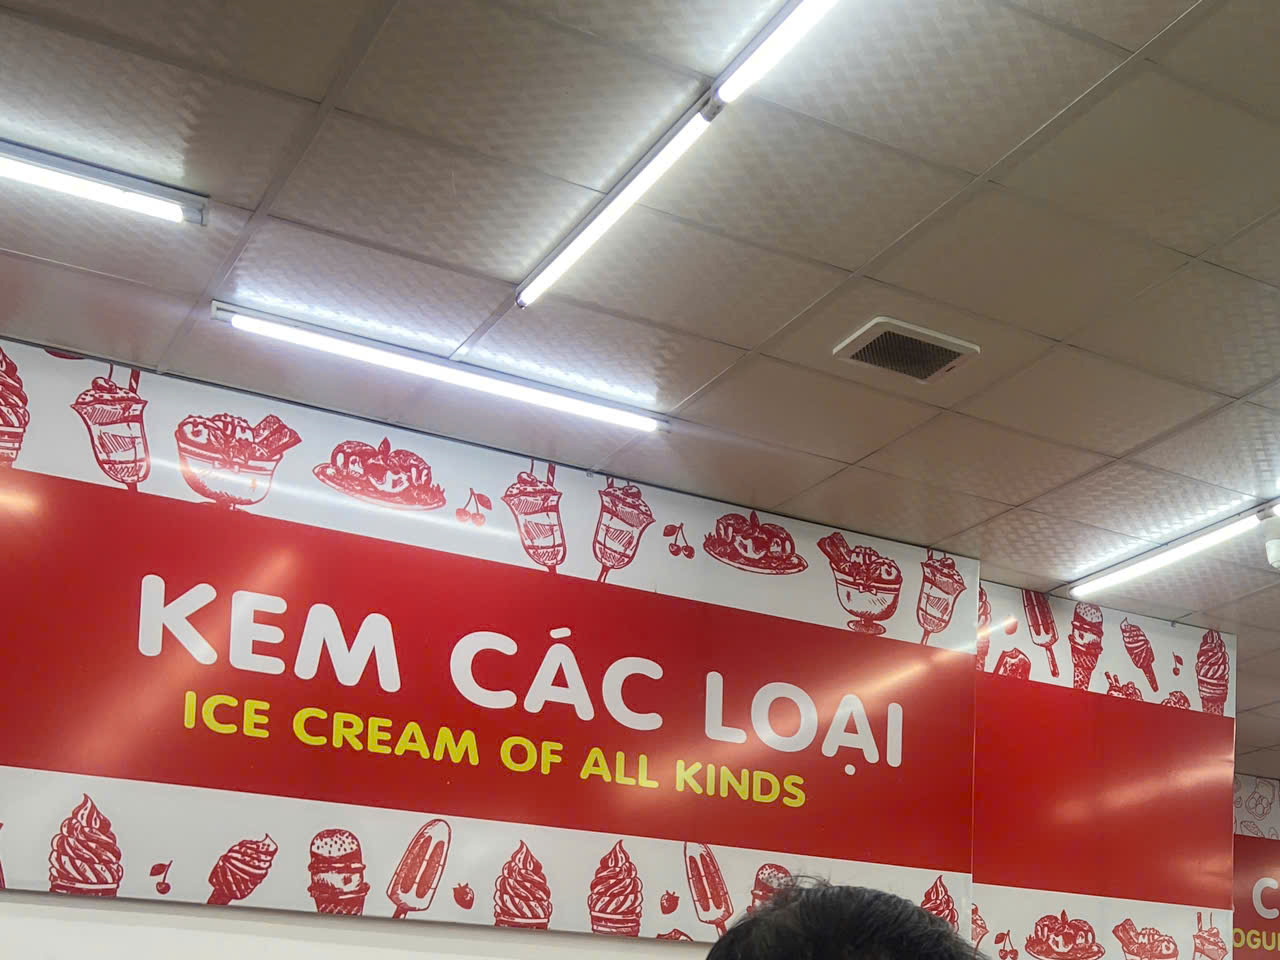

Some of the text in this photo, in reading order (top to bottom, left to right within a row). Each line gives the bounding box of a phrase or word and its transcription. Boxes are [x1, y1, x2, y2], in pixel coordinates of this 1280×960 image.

[137, 574, 903, 775] KEM CÁC LOẠI
[183, 690, 807, 808] ICE CREAM OF ALL KINDS
